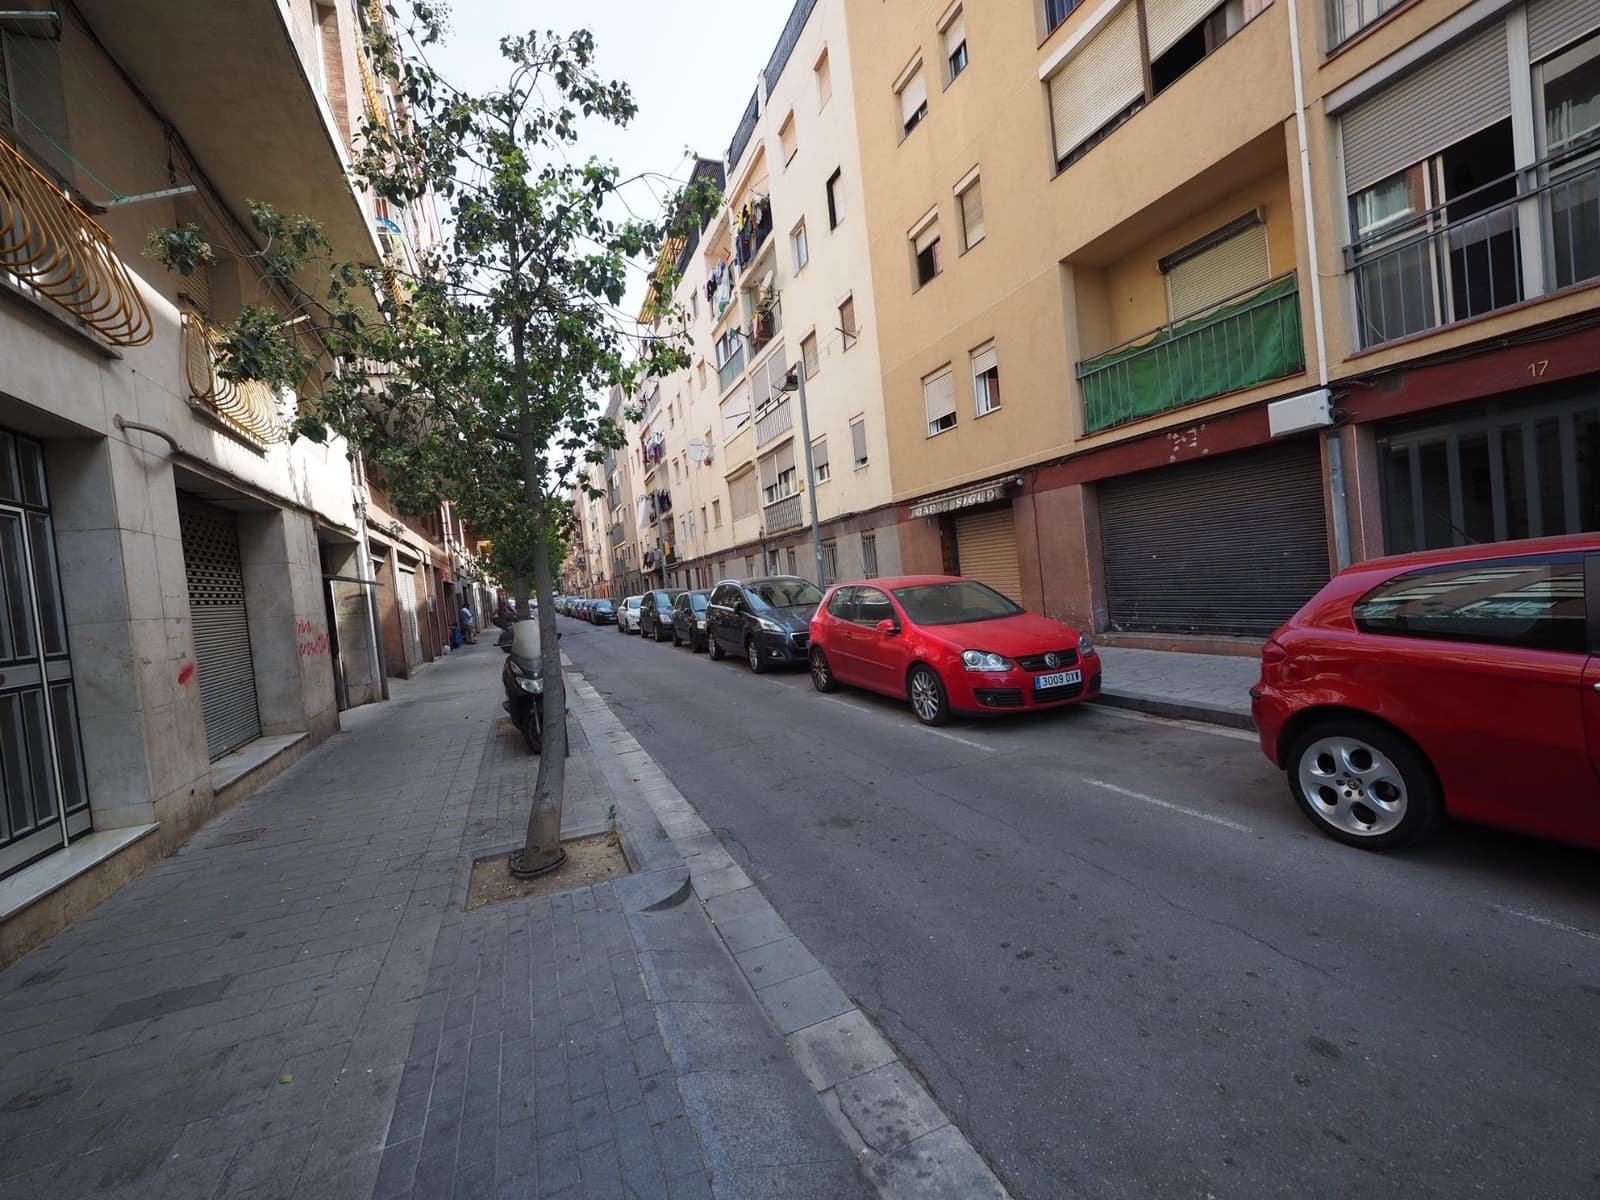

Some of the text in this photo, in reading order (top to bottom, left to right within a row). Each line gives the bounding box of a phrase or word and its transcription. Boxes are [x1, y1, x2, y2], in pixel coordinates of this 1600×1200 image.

[1527, 360, 1549, 377] 17
[915, 504, 937, 517] BAR
[1042, 674, 1064, 686] 3009
